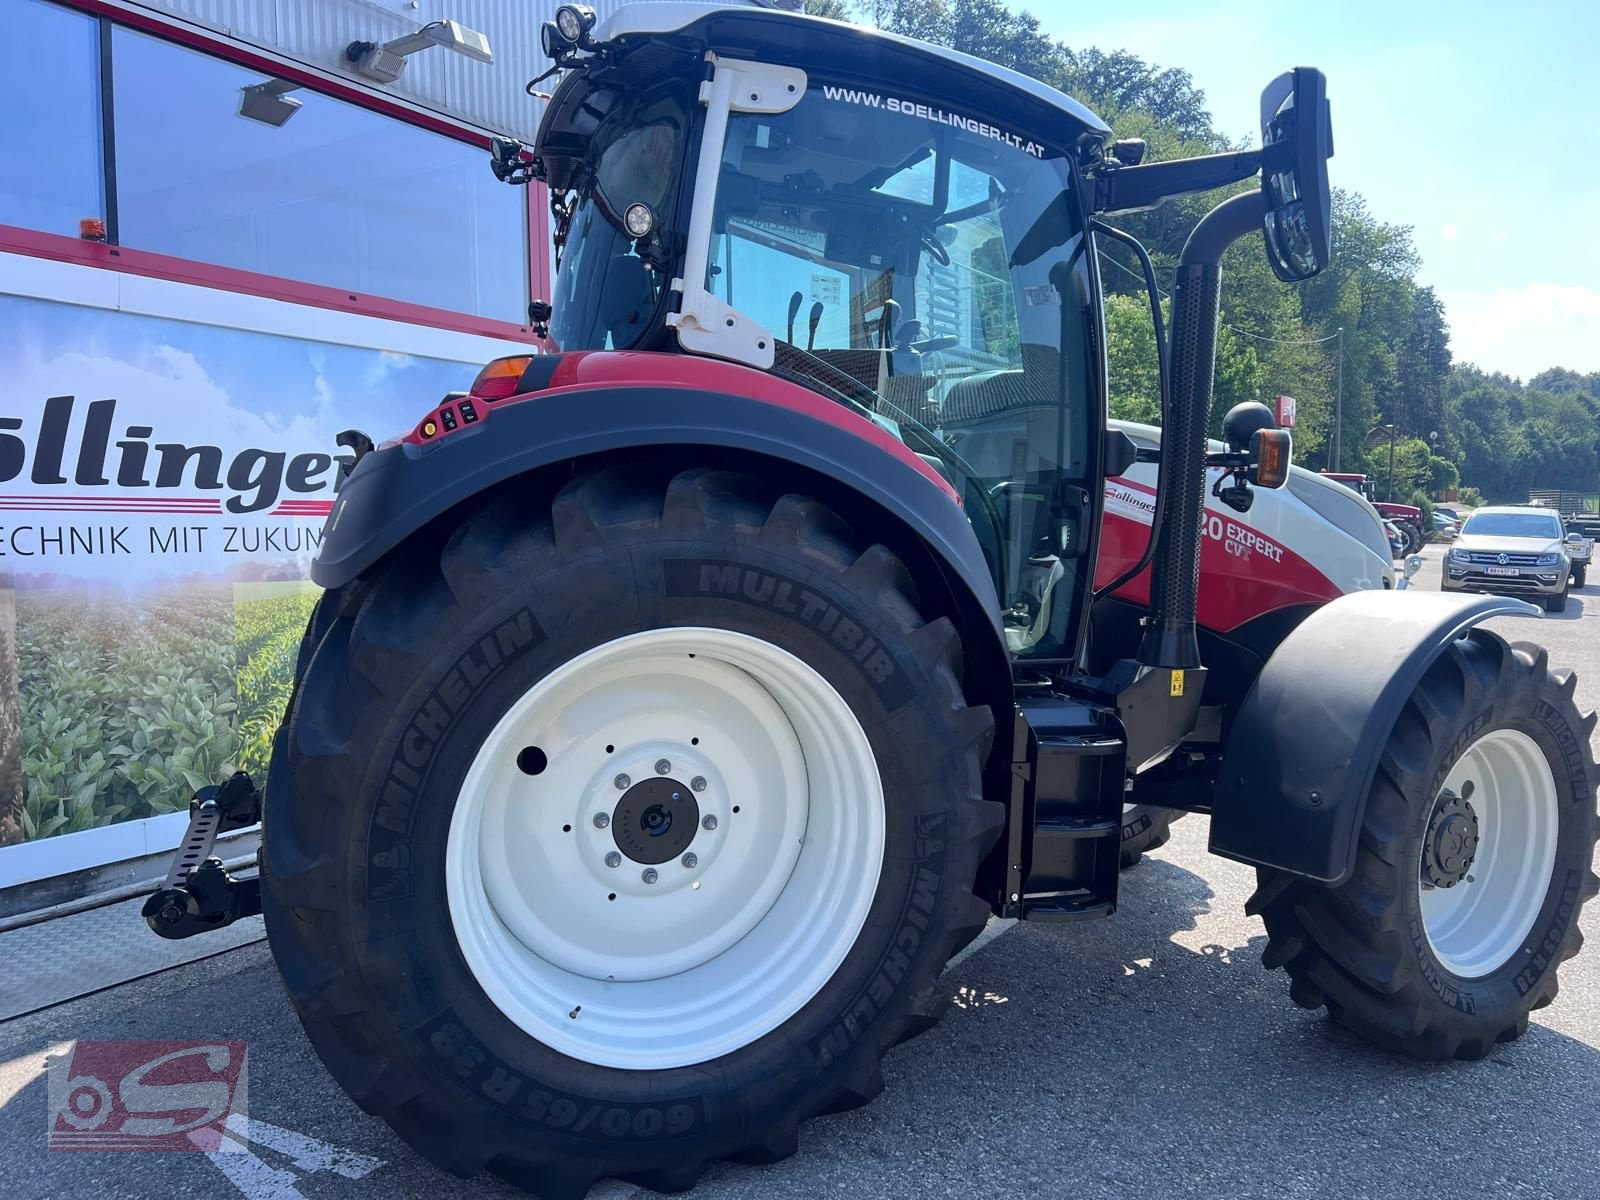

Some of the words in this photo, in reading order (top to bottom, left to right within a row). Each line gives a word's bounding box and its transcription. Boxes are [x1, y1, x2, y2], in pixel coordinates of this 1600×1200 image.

[823, 85, 1045, 159] WWW.SOELLINGER-LT.AT
[150, 526, 208, 554] MIT
[1224, 539, 1252, 562] CVT
[1226, 522, 1284, 564] EXPERT
[700, 564, 894, 684] MULTIBIB
[375, 610, 536, 834] MICHELIN
[817, 866, 941, 1068] MICHELIN
[480, 1067, 522, 1104] R
[521, 1089, 696, 1138] 600/65
